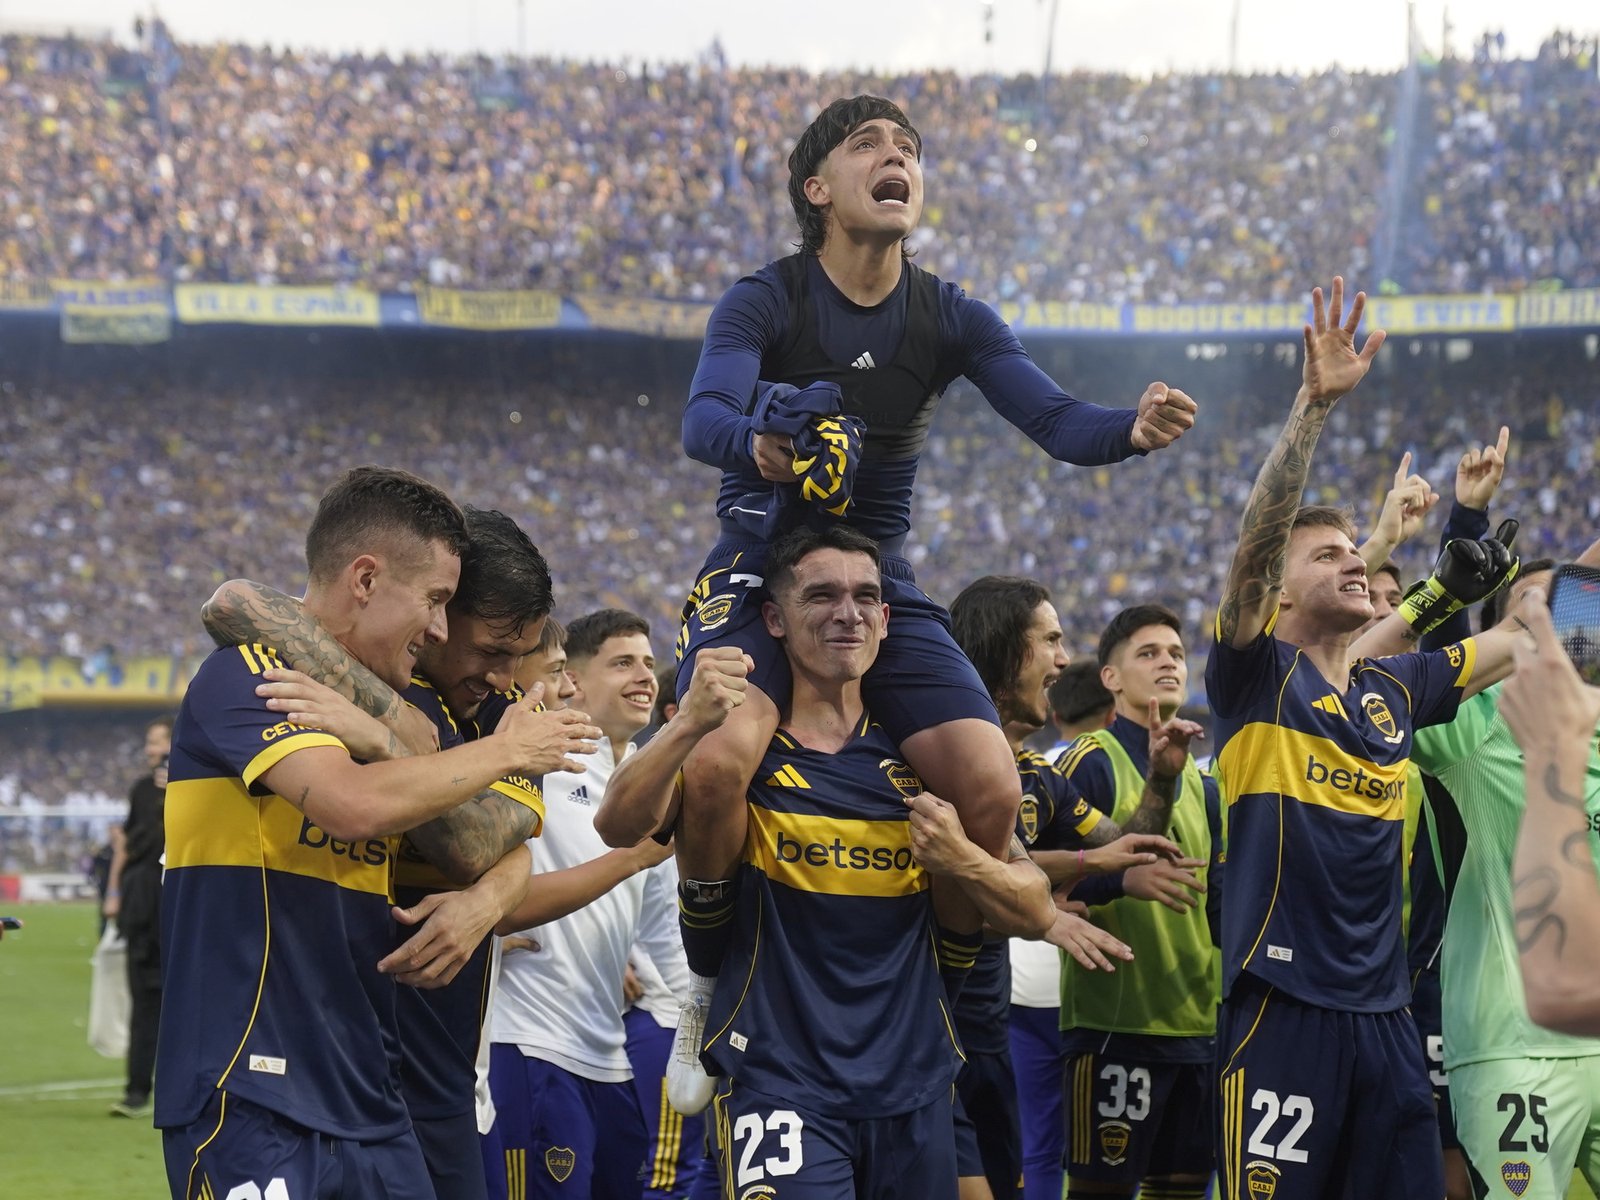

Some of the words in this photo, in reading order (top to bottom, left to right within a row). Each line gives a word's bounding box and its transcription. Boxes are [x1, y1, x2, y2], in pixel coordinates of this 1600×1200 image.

[895, 779, 919, 787] CABJ
[567, 795, 591, 807] adidas
[776, 832, 917, 871] betsso
[1098, 1064, 1151, 1121] 33
[1247, 1088, 1315, 1164] 22
[1497, 1093, 1549, 1154] 25
[733, 1109, 804, 1188] 23
[549, 1158, 572, 1167] CABJ
[1252, 1182, 1272, 1193] CABJ
[1504, 1172, 1529, 1181] CABJ
